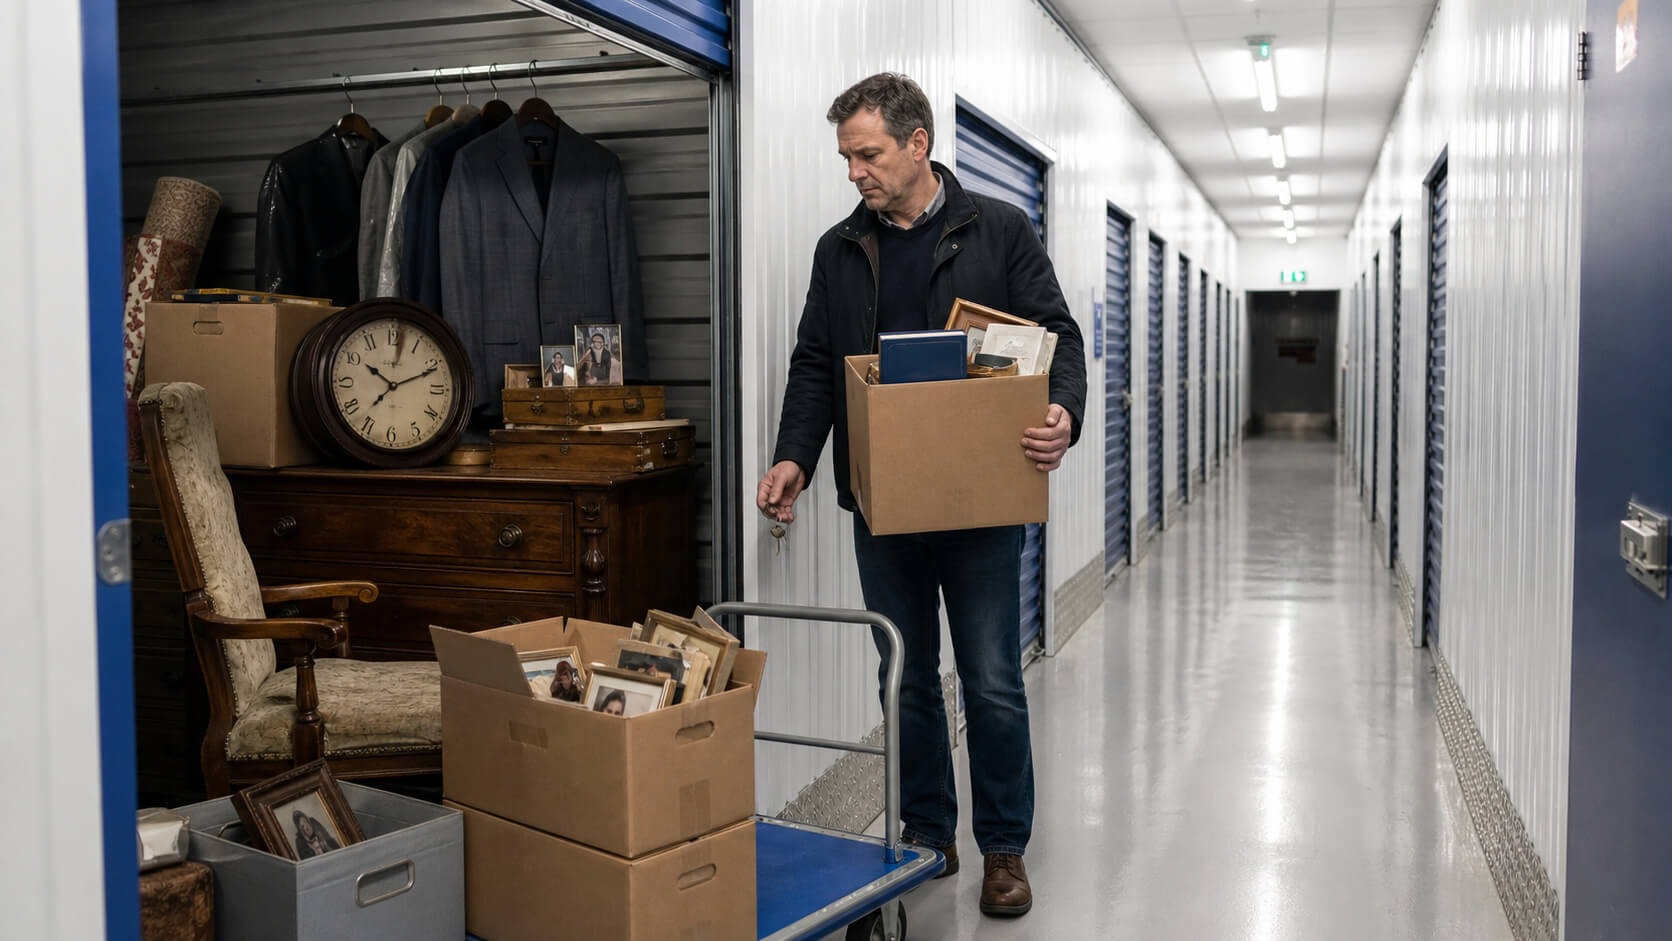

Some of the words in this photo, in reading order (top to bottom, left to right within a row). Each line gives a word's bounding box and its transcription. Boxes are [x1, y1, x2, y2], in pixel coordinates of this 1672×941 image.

[387, 329, 400, 346] 12
[346, 351, 361, 366] 10
[386, 426, 397, 442] 6
[410, 421, 421, 437] 5
